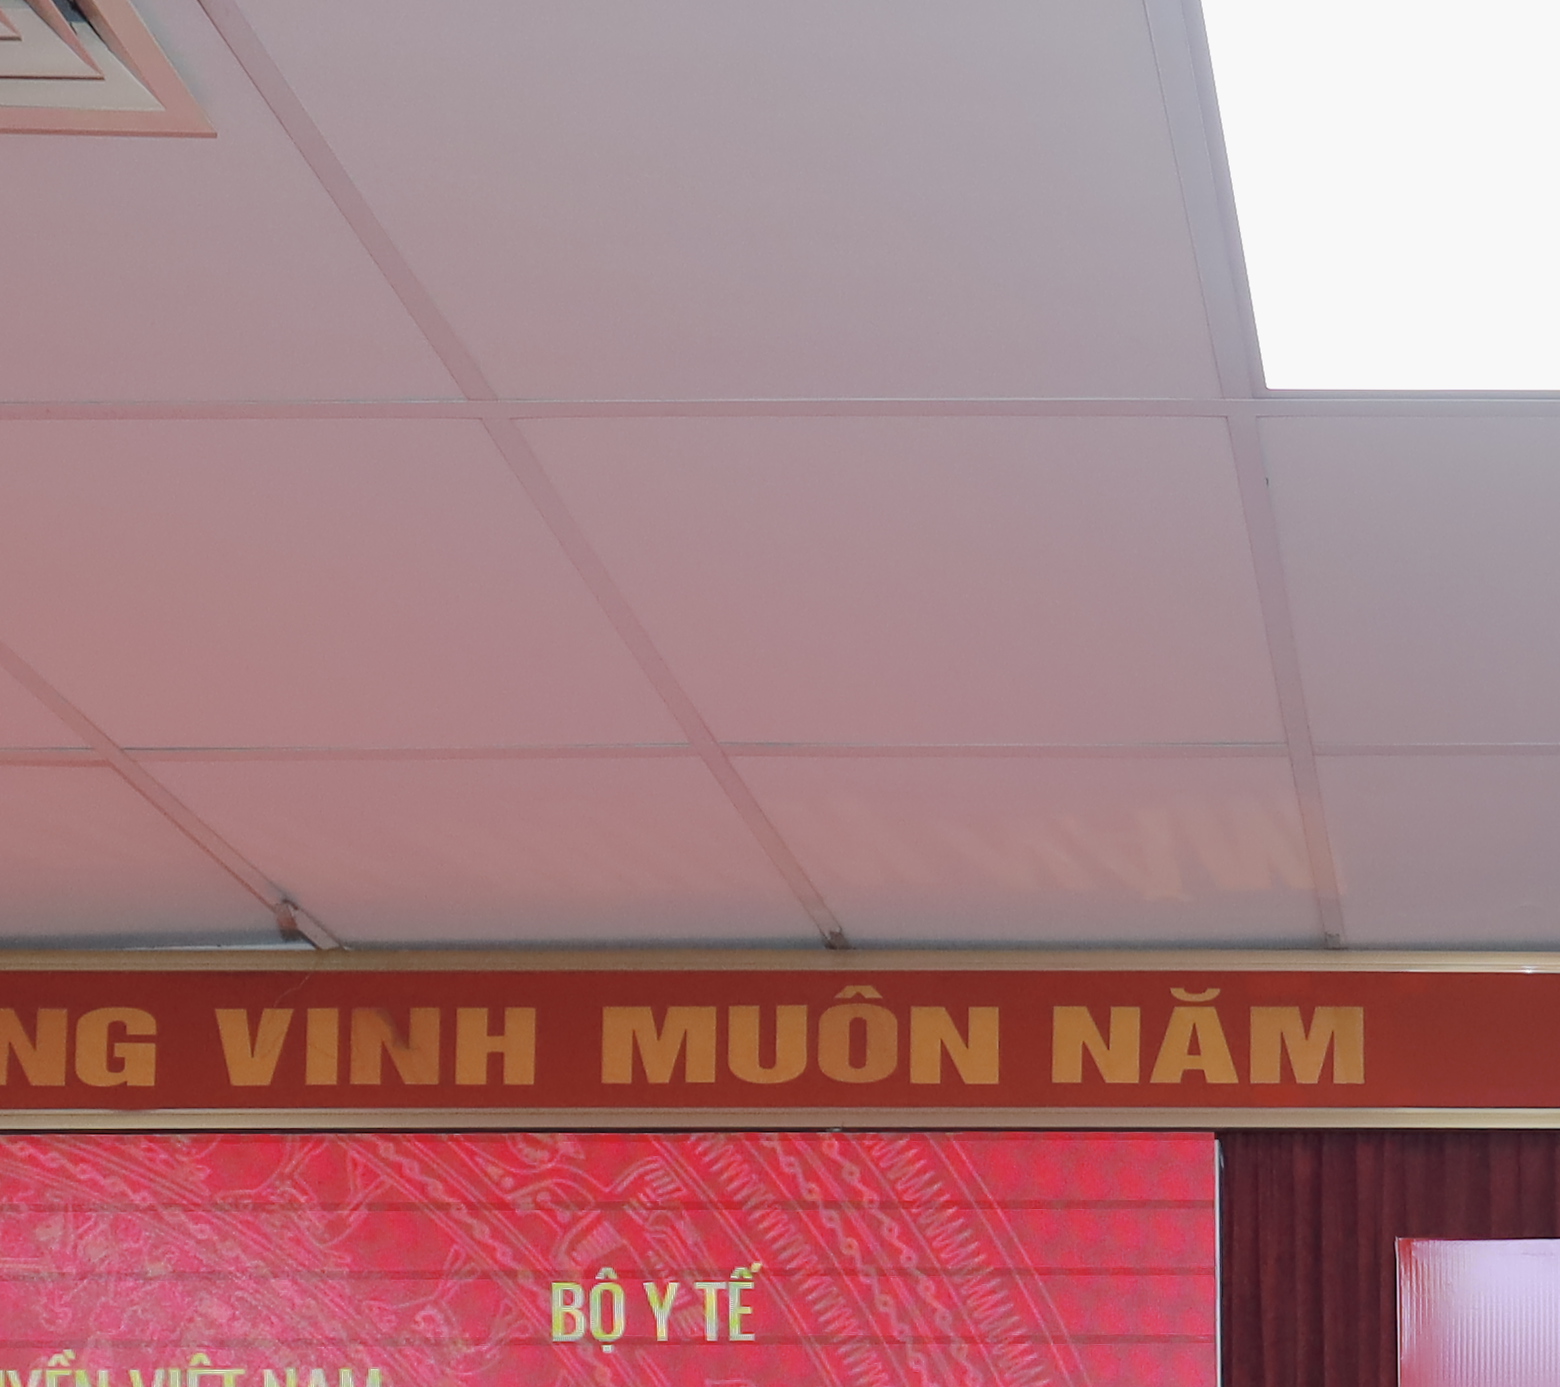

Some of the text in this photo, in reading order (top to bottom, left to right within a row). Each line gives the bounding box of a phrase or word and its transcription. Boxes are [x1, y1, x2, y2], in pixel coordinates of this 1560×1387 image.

[217, 1008, 536, 1086] VINH
[603, 986, 1000, 1084] MUÔN
[1053, 988, 1364, 1084] NĂM
[552, 1262, 762, 1353] BỘ Y TẾ
